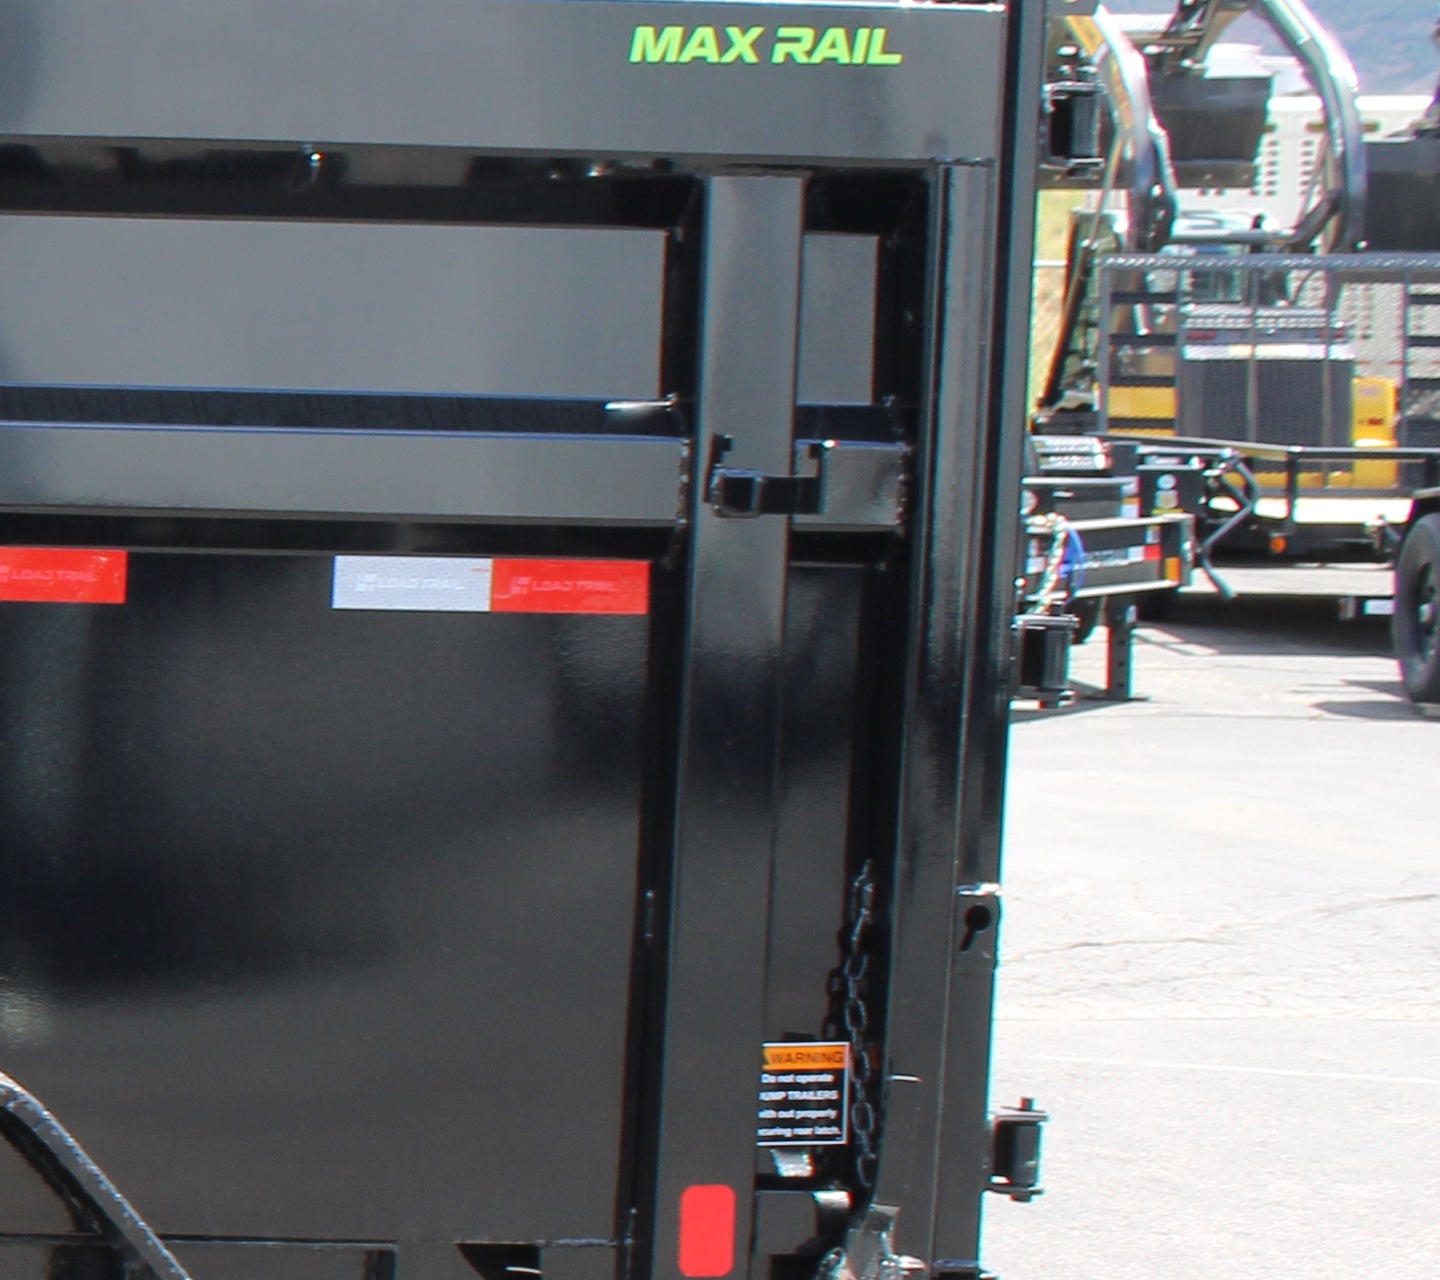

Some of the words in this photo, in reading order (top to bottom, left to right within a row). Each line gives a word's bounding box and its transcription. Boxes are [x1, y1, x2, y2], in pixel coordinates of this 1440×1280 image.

[629, 25, 765, 64] MAX
[770, 26, 903, 65] RAIL
[12, 568, 52, 580] LOAD
[532, 580, 573, 591] LOAD
[767, 1051, 844, 1064] WARNING
[761, 1073, 777, 1084] Do
[777, 1074, 795, 1084] not
[795, 1073, 834, 1085] operate
[787, 1090, 839, 1100] TRAILERS
[795, 1108, 837, 1120] properly
